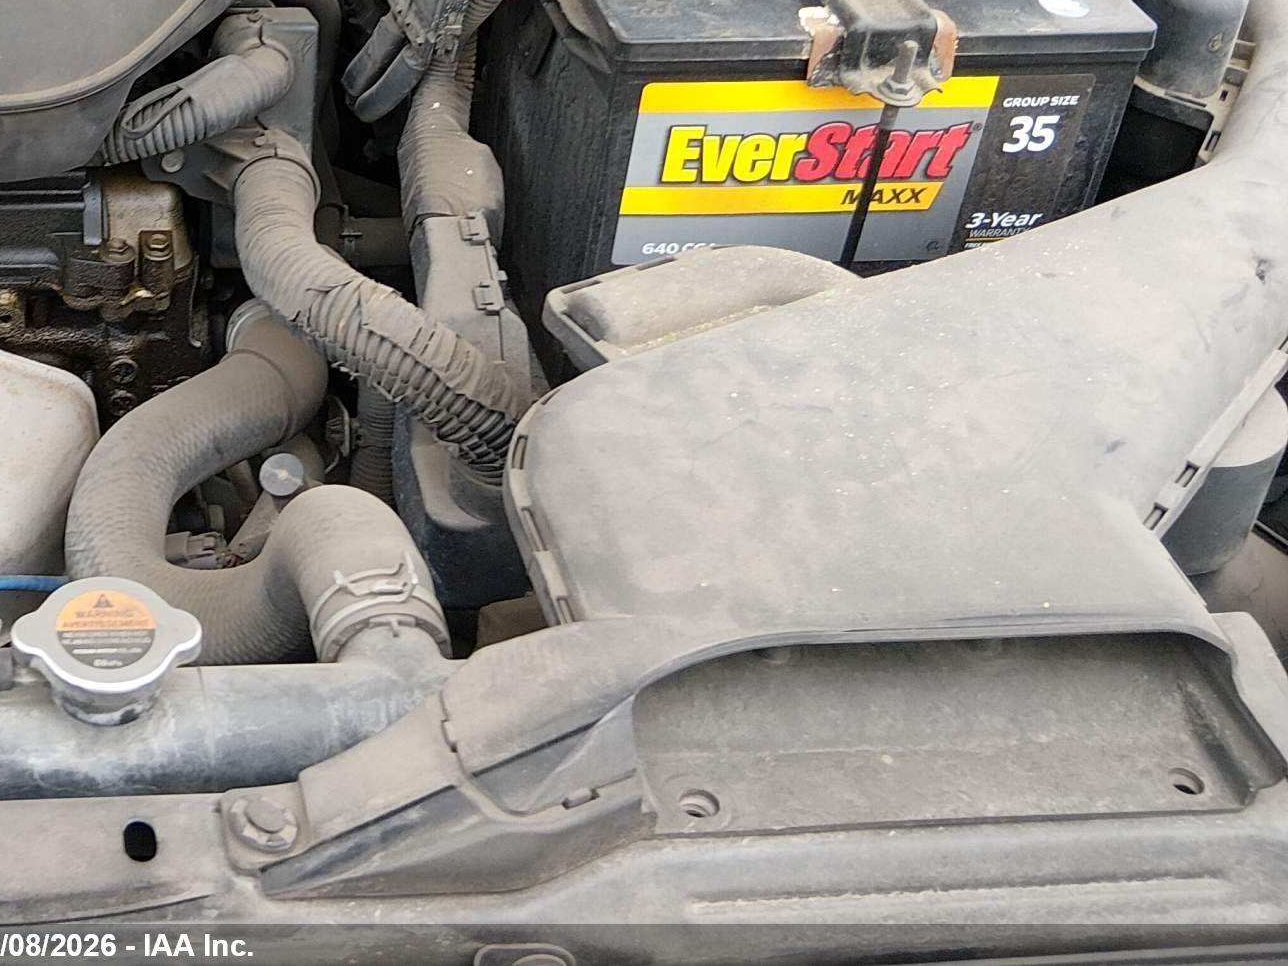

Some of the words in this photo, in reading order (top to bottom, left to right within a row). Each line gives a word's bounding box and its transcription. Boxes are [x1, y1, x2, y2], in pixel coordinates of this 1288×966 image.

[1003, 96, 1050, 108] GROUP
[1050, 95, 1080, 106] SIZE
[1002, 115, 1060, 153] 35
[660, 122, 974, 183] EverStart
[841, 187, 927, 205] MAXX
[965, 211, 1043, 229] 3-Year
[642, 242, 680, 255] 640
